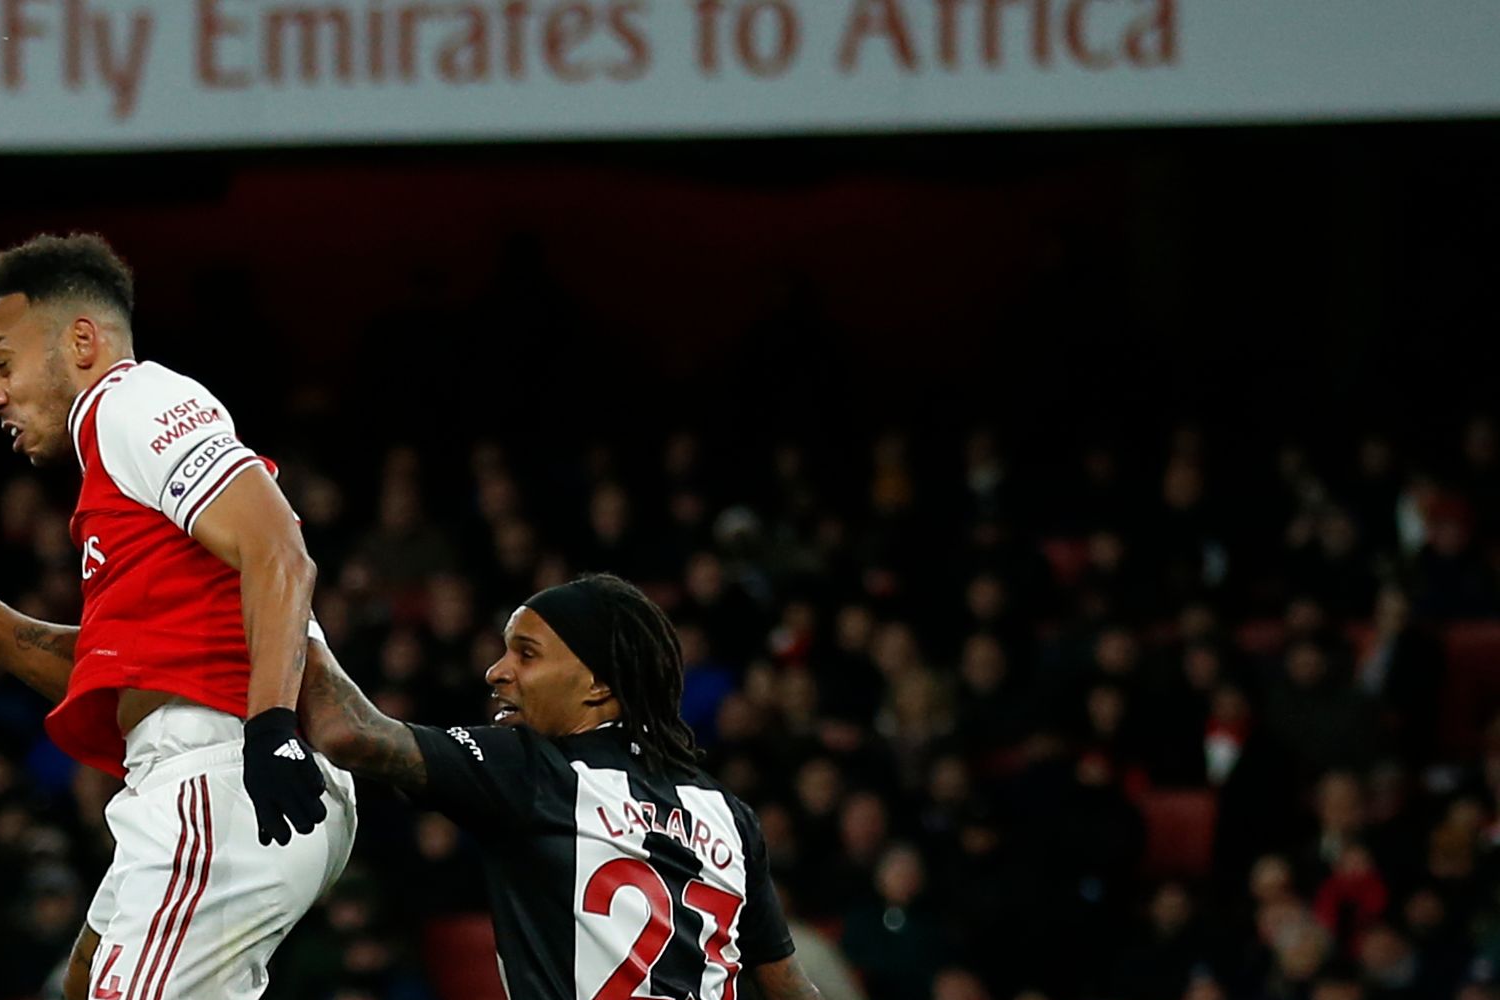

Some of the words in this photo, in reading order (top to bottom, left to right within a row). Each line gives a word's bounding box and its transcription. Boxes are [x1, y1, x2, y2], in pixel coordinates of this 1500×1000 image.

[196, 0, 651, 87] Emirates
[693, 0, 801, 78] to
[836, 0, 1184, 72] Africa
[154, 398, 201, 427] VISIT
[182, 436, 235, 479] Capta
[596, 801, 733, 871] LAZARO
